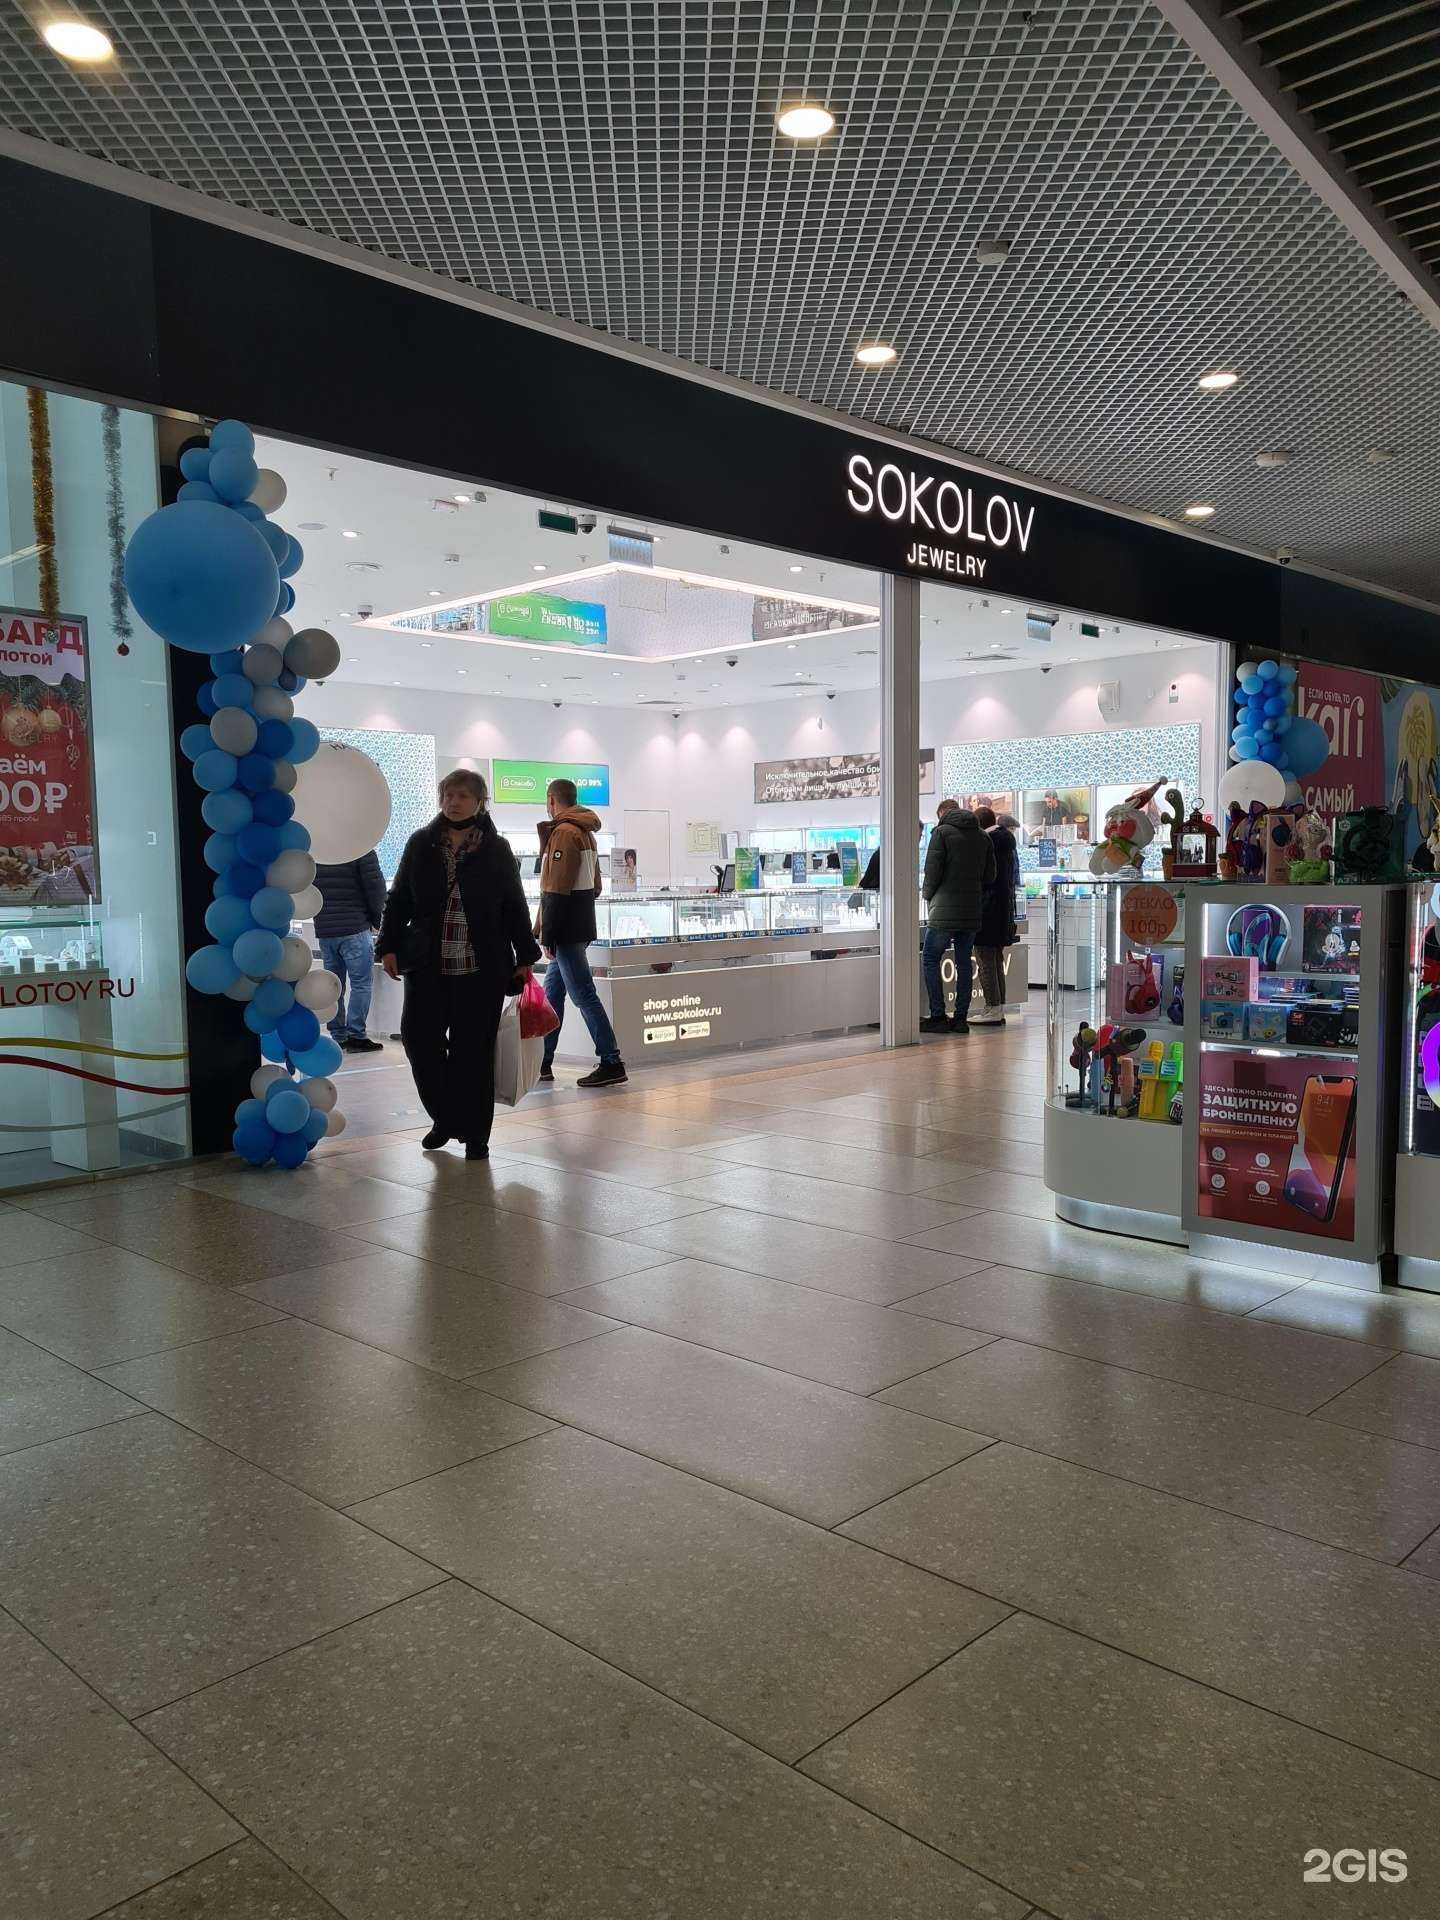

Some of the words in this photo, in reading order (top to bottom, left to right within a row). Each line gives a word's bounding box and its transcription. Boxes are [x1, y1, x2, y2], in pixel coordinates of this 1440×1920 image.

[848, 455, 1035, 552] SOKOLOV
[907, 543, 987, 578] JEWELRY
[1308, 687, 1324, 699] ЕСЛИ
[765, 769, 828, 780] Исключительное
[829, 767, 865, 777] качество
[1305, 784, 1355, 812] САМЫЙ
[1129, 919, 1167, 937] 100р
[0, 980, 93, 1007] LOTOY
[99, 978, 135, 1000] RU
[643, 998, 669, 1011] shop
[670, 994, 701, 1008] online
[643, 1006, 722, 1024] www.sokolov.ru
[1204, 1085, 1226, 1093] ЗДЕСЬ
[1226, 1087, 1256, 1096] МОЖНО
[1257, 1090, 1298, 1100] ПОКЛЕИТЬ
[1203, 1093, 1298, 1114] ЗАЩИТНУЮ
[1202, 1108, 1297, 1127] БРОНЕПЛЕНКУ
